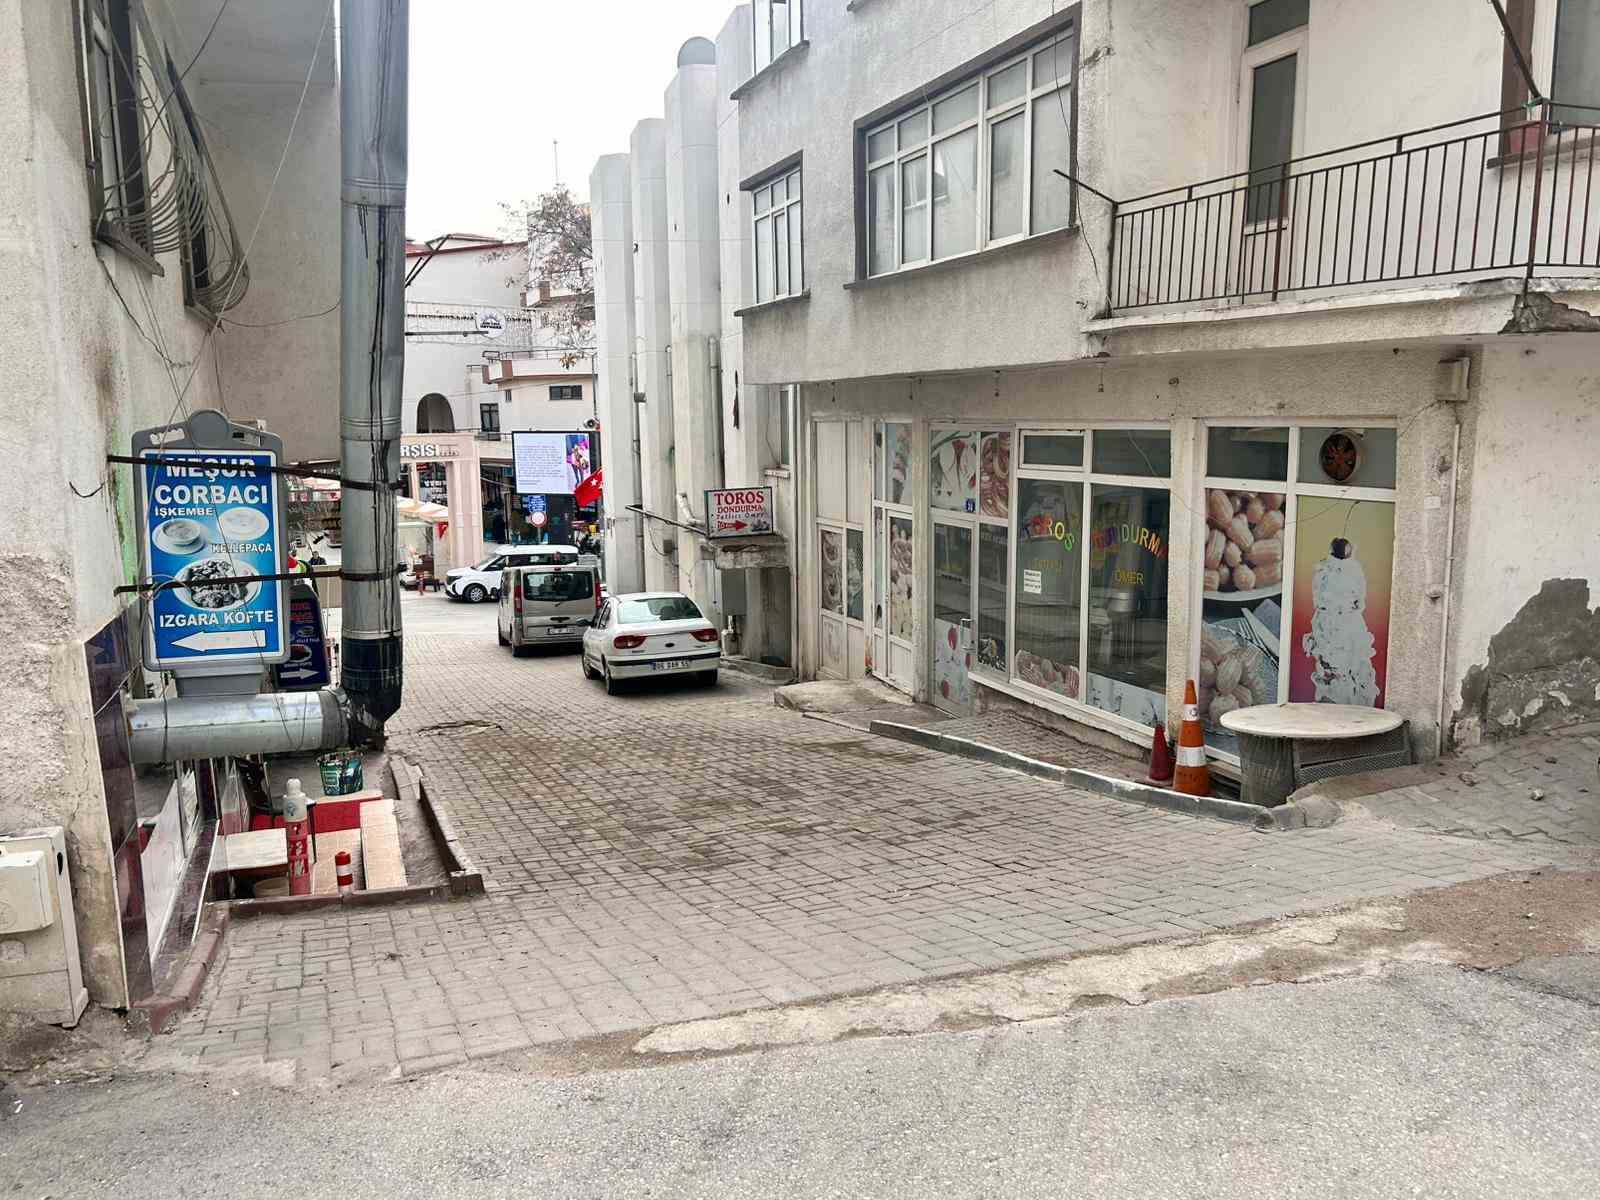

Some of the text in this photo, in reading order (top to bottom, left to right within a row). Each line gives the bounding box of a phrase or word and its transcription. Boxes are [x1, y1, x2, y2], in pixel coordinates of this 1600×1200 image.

[714, 490, 765, 506] TOROS
[717, 504, 763, 514] DONDURMA
[160, 612, 219, 628] IZGARA
